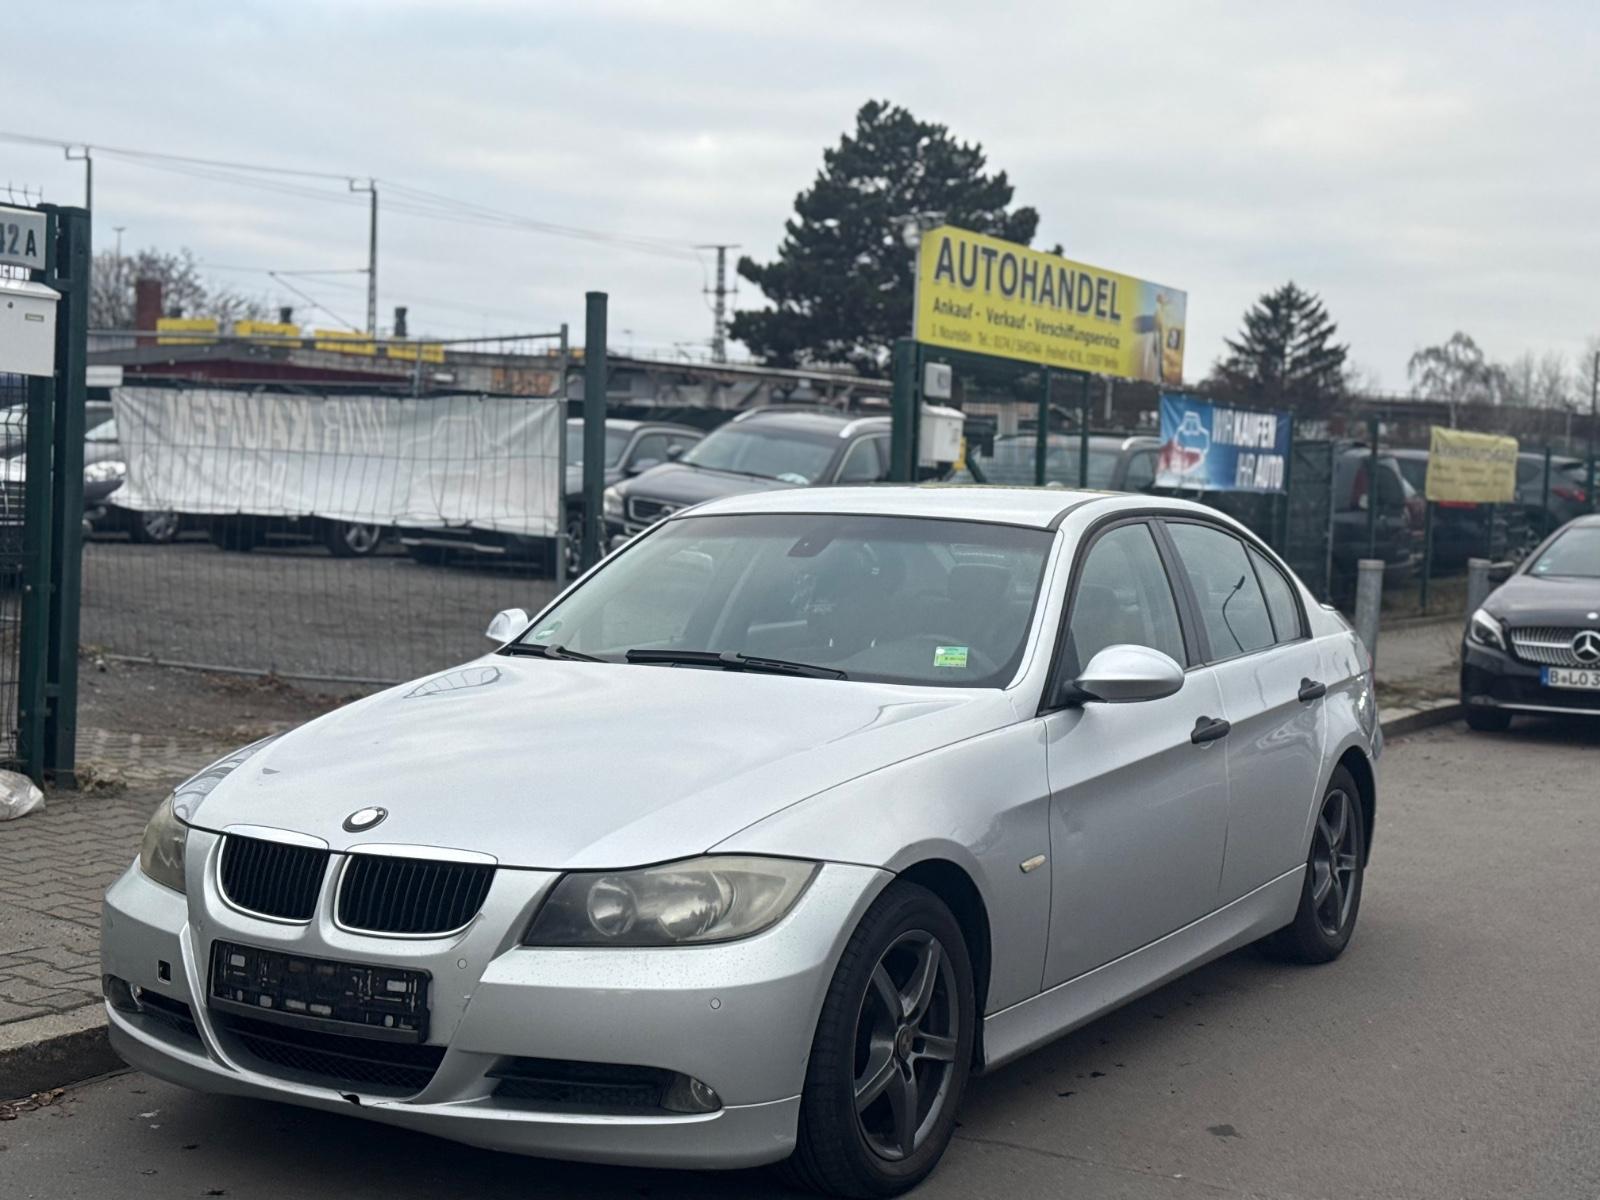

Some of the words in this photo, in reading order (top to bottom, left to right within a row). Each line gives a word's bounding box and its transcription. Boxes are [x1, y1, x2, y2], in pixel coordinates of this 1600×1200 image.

[25, 228, 37, 257] A
[934, 236, 1121, 321] AUTOHANDEL
[933, 297, 974, 320] Ankauf
[986, 307, 1026, 330] Verkauf
[1550, 670, 1559, 684] B
